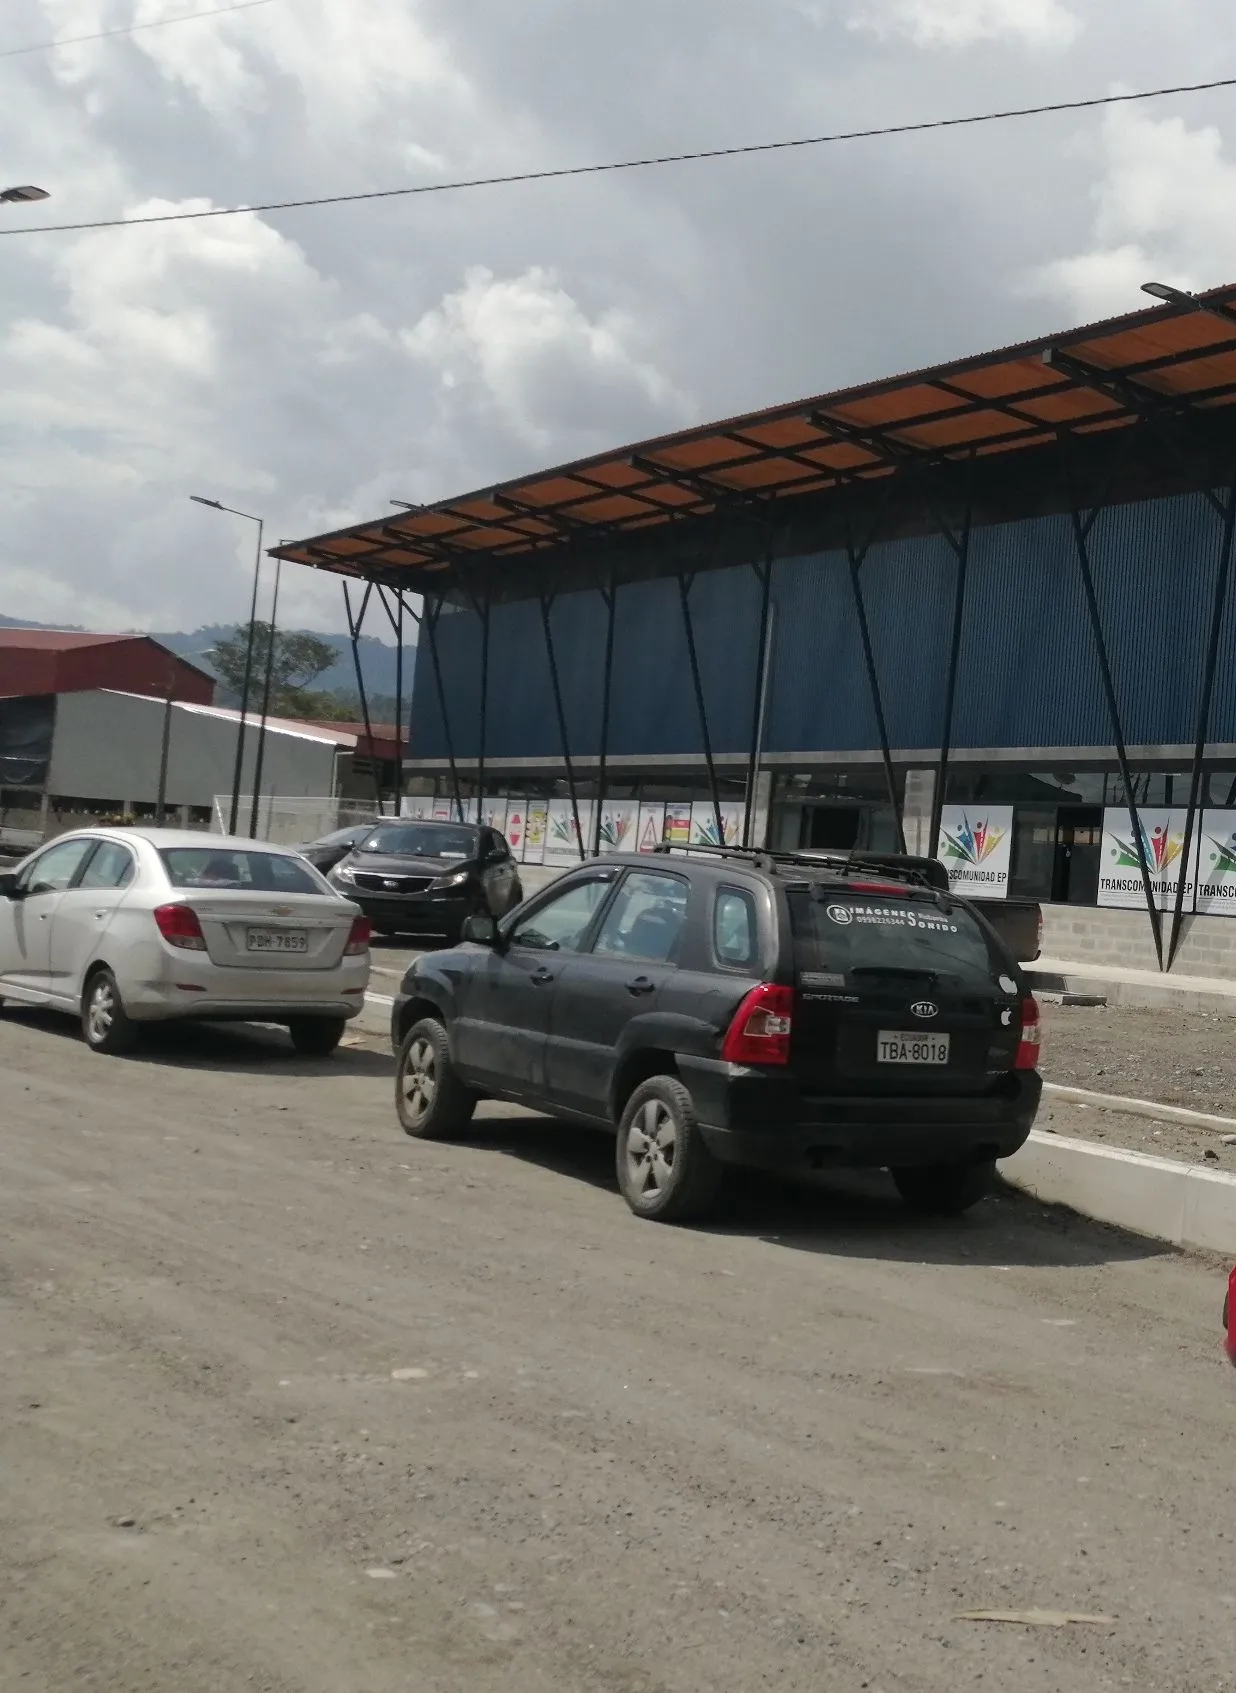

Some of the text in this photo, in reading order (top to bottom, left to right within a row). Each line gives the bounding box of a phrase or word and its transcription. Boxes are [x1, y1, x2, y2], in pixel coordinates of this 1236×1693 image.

[947, 869, 1007, 883] SCOMUNIDAD EP
[915, 1004, 935, 1015] KIA
[880, 1041, 947, 1062] TBA-8018
